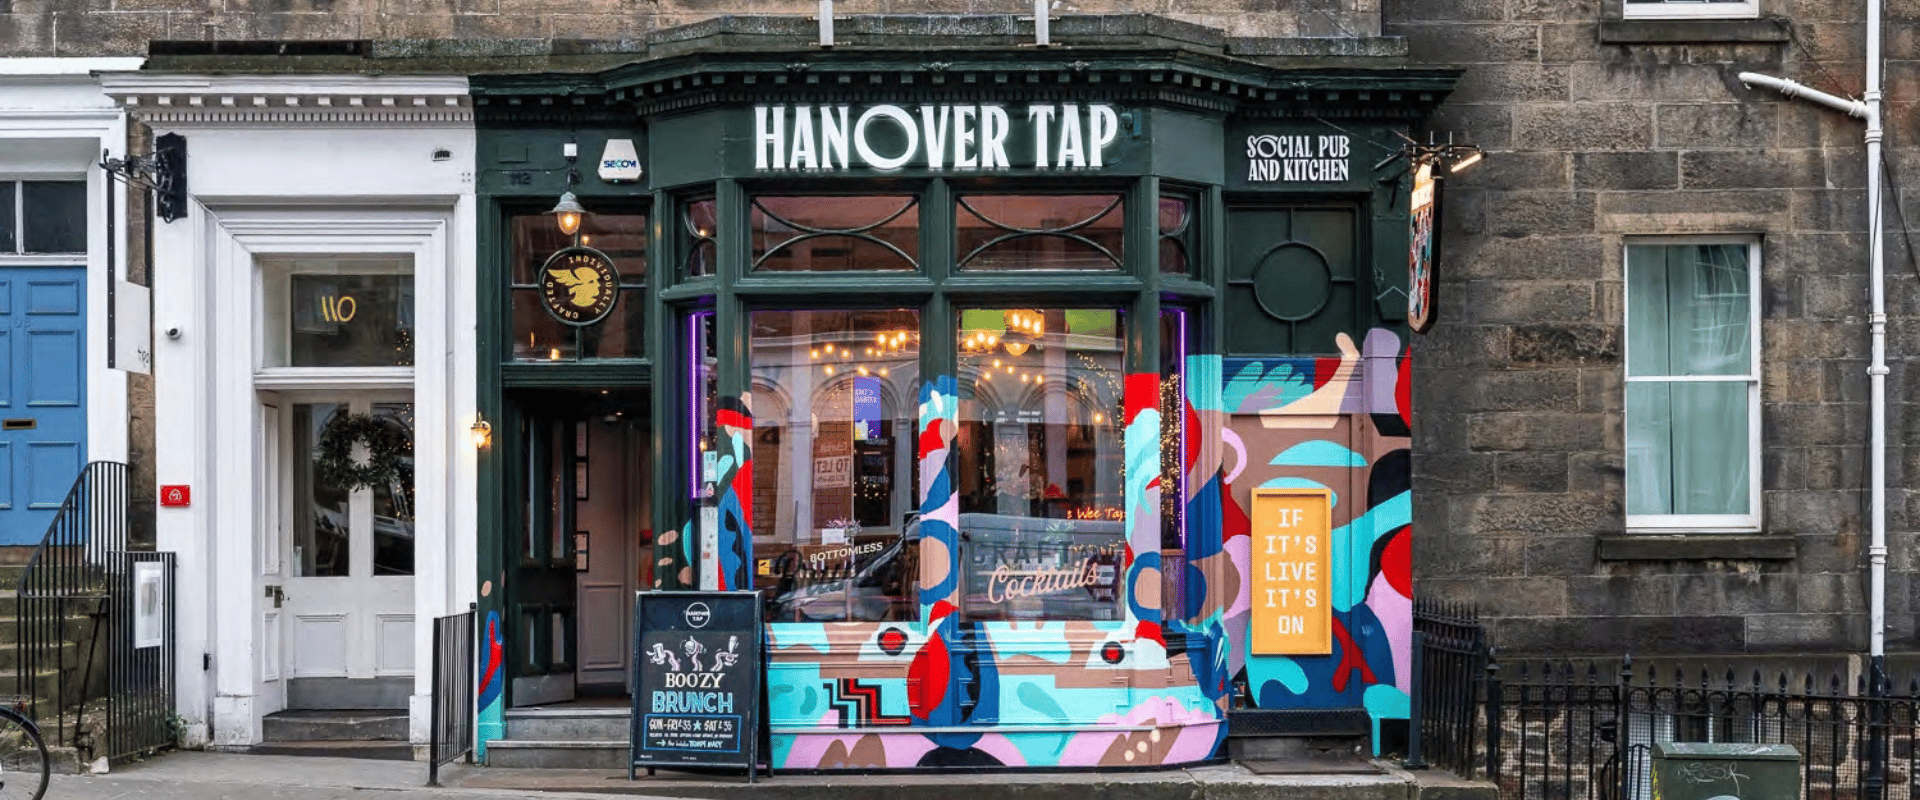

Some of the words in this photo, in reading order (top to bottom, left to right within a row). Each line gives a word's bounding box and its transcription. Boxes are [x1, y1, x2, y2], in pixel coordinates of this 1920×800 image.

[755, 104, 1010, 169] HANOVER
[1028, 104, 1118, 168] TAP
[1247, 134, 1313, 158] SOCIAL
[1318, 135, 1350, 158] PUB
[603, 159, 637, 168] SECOM
[1248, 159, 1281, 181] AND
[1283, 159, 1349, 181] KITCHEN
[568, 255, 613, 314] INDIVIDUALLY
[321, 295, 356, 322] 110
[546, 281, 579, 320] CRAFTED
[1278, 508, 1303, 527] IF
[810, 542, 883, 563] BOTTOMLESS
[1265, 535, 1317, 554] IT'S
[988, 557, 1098, 604] Cocktails
[1265, 561, 1317, 581] LIVE
[1265, 588, 1317, 607] IT'S
[1278, 615, 1304, 634] ON
[664, 672, 726, 688] BOOZY
[652, 690, 733, 714] BRUNCH
[703, 720, 718, 732] SAT
